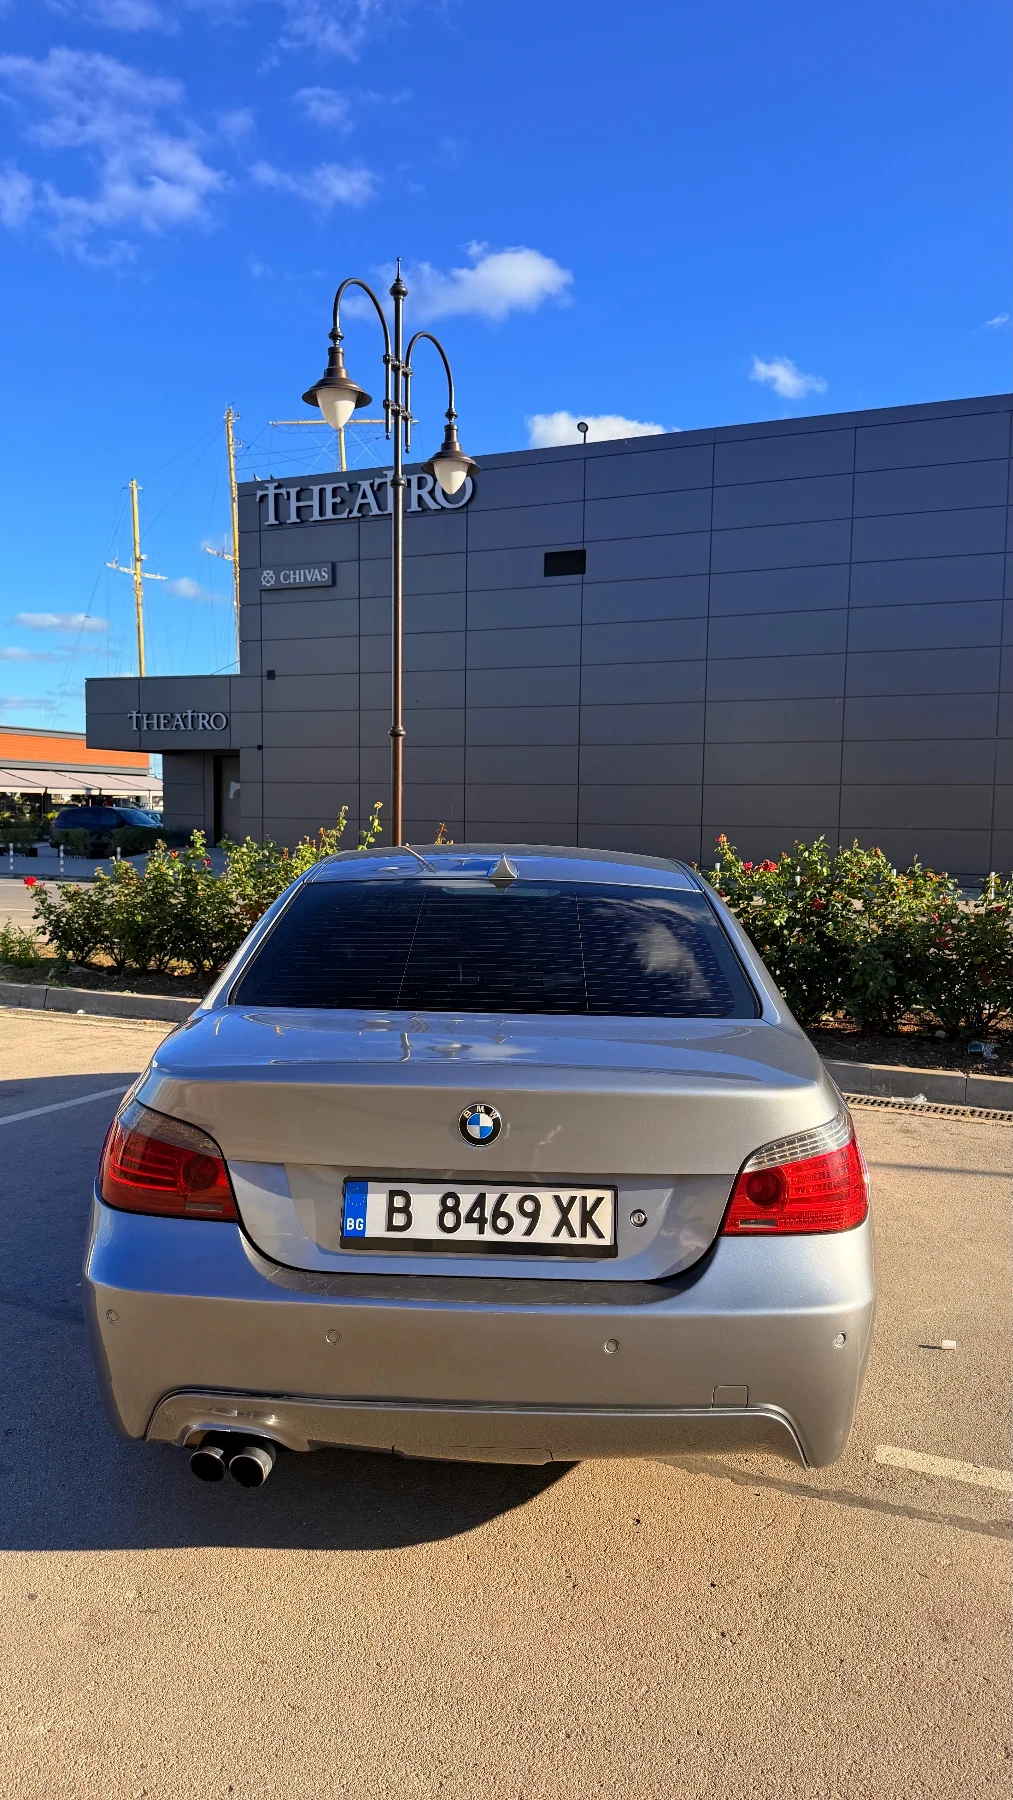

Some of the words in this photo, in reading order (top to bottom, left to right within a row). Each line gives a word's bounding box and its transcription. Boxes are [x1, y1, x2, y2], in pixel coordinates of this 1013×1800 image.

[256, 469, 474, 526] THEATRO
[279, 567, 329, 584] CHIVAS
[127, 709, 228, 731] THEATRO
[463, 1105, 499, 1120] BMW
[385, 1189, 413, 1233] B
[438, 1191, 542, 1237] 8469
[551, 1194, 606, 1239] XK
[346, 1217, 364, 1231] BG
